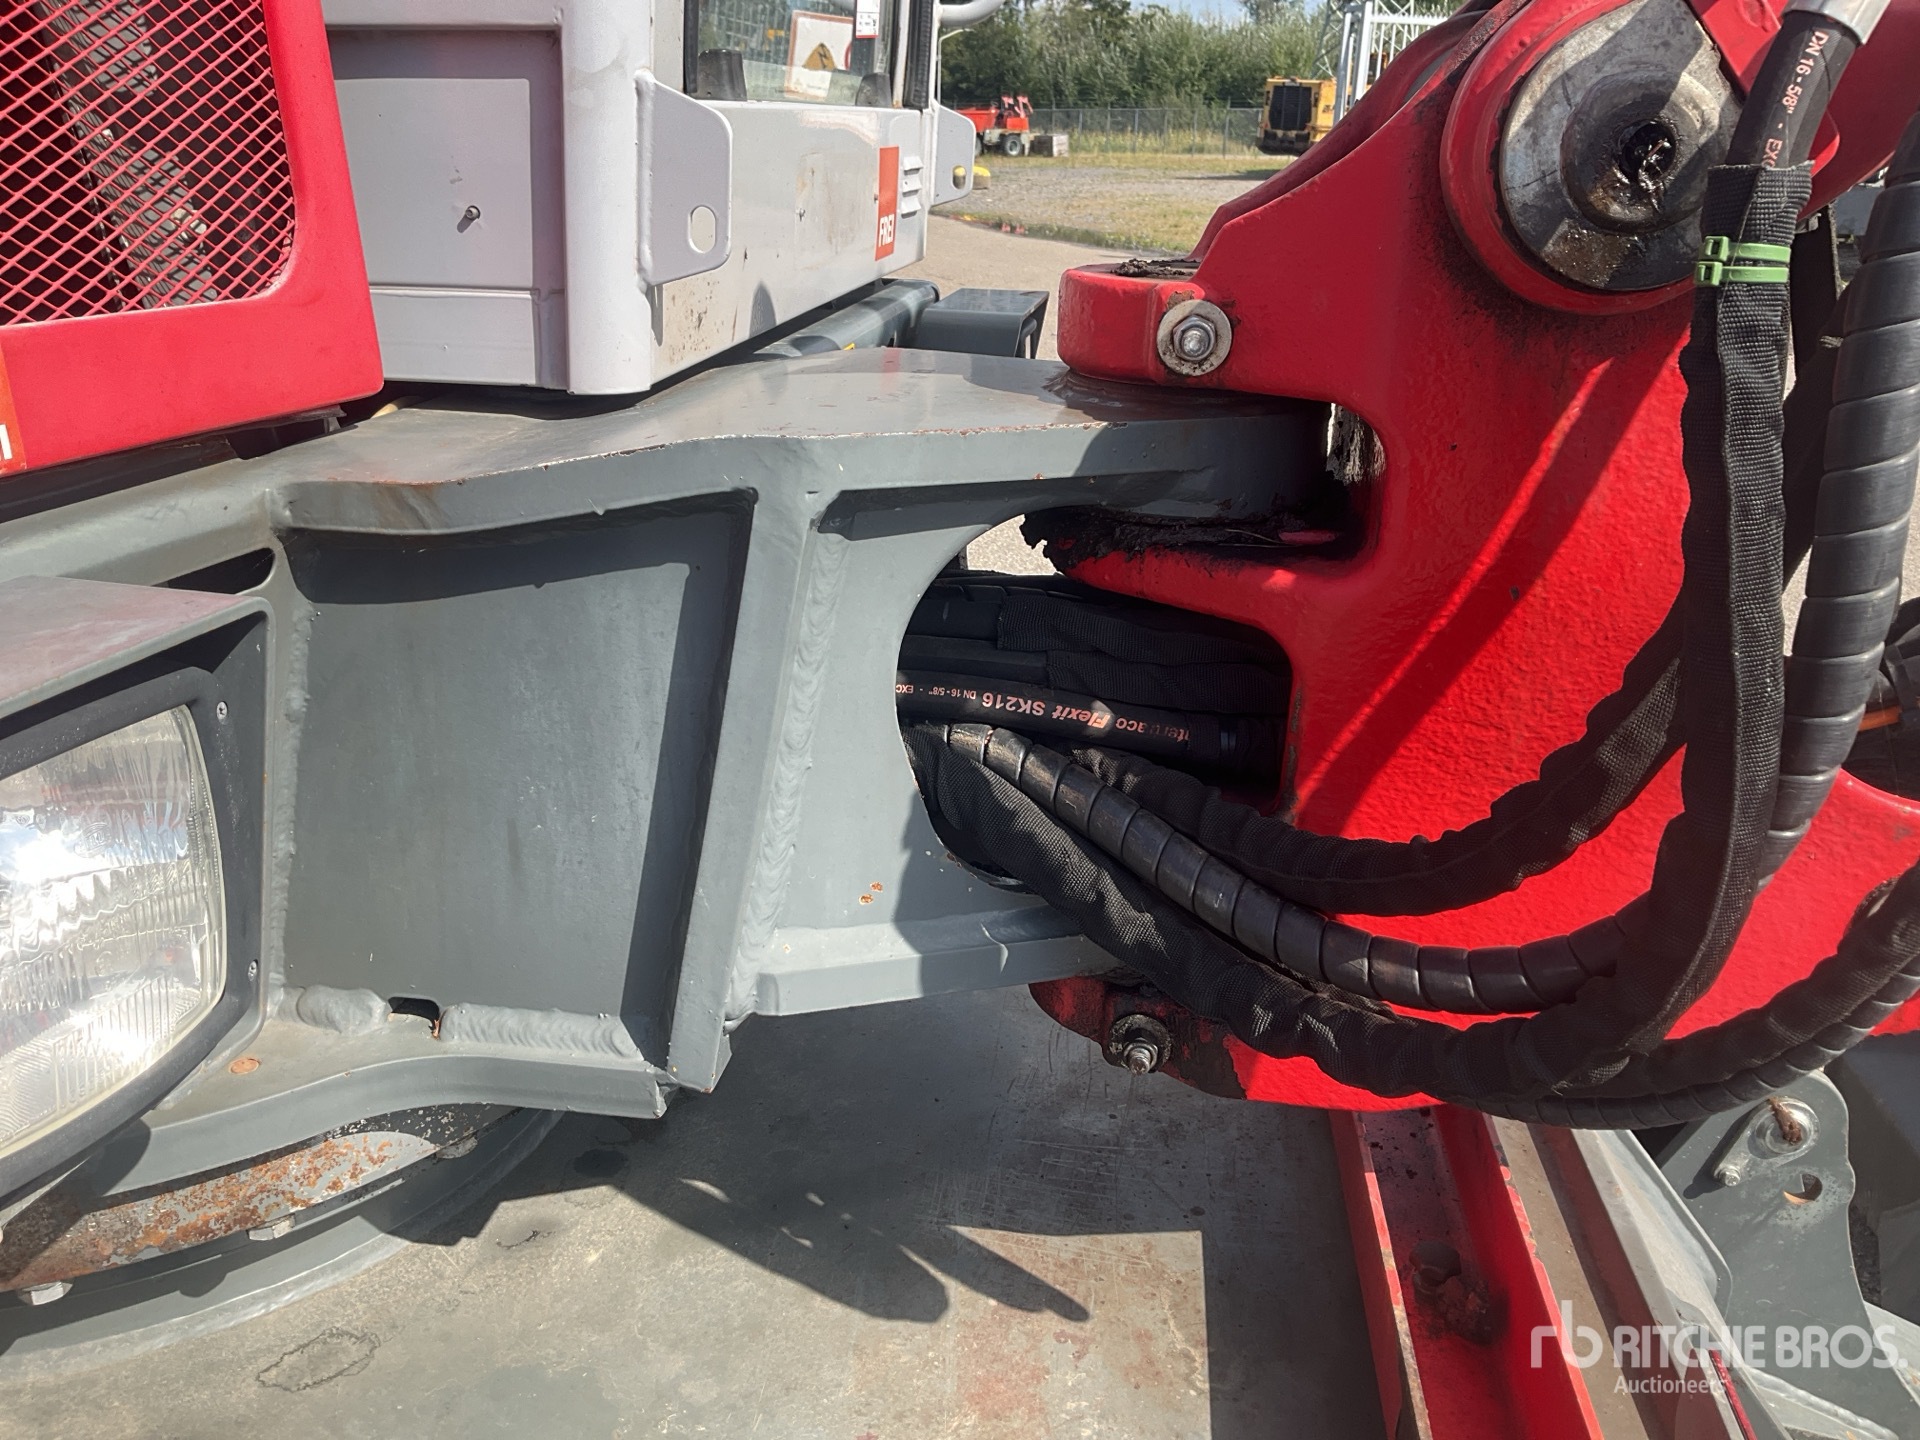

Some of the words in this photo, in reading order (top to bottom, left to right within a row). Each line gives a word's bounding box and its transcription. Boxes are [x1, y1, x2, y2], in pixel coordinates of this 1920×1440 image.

[1805, 31, 1829, 56] DN
[962, 689, 977, 700] DN
[981, 691, 1046, 716] SK216
[1051, 704, 1111, 729] Flexit
